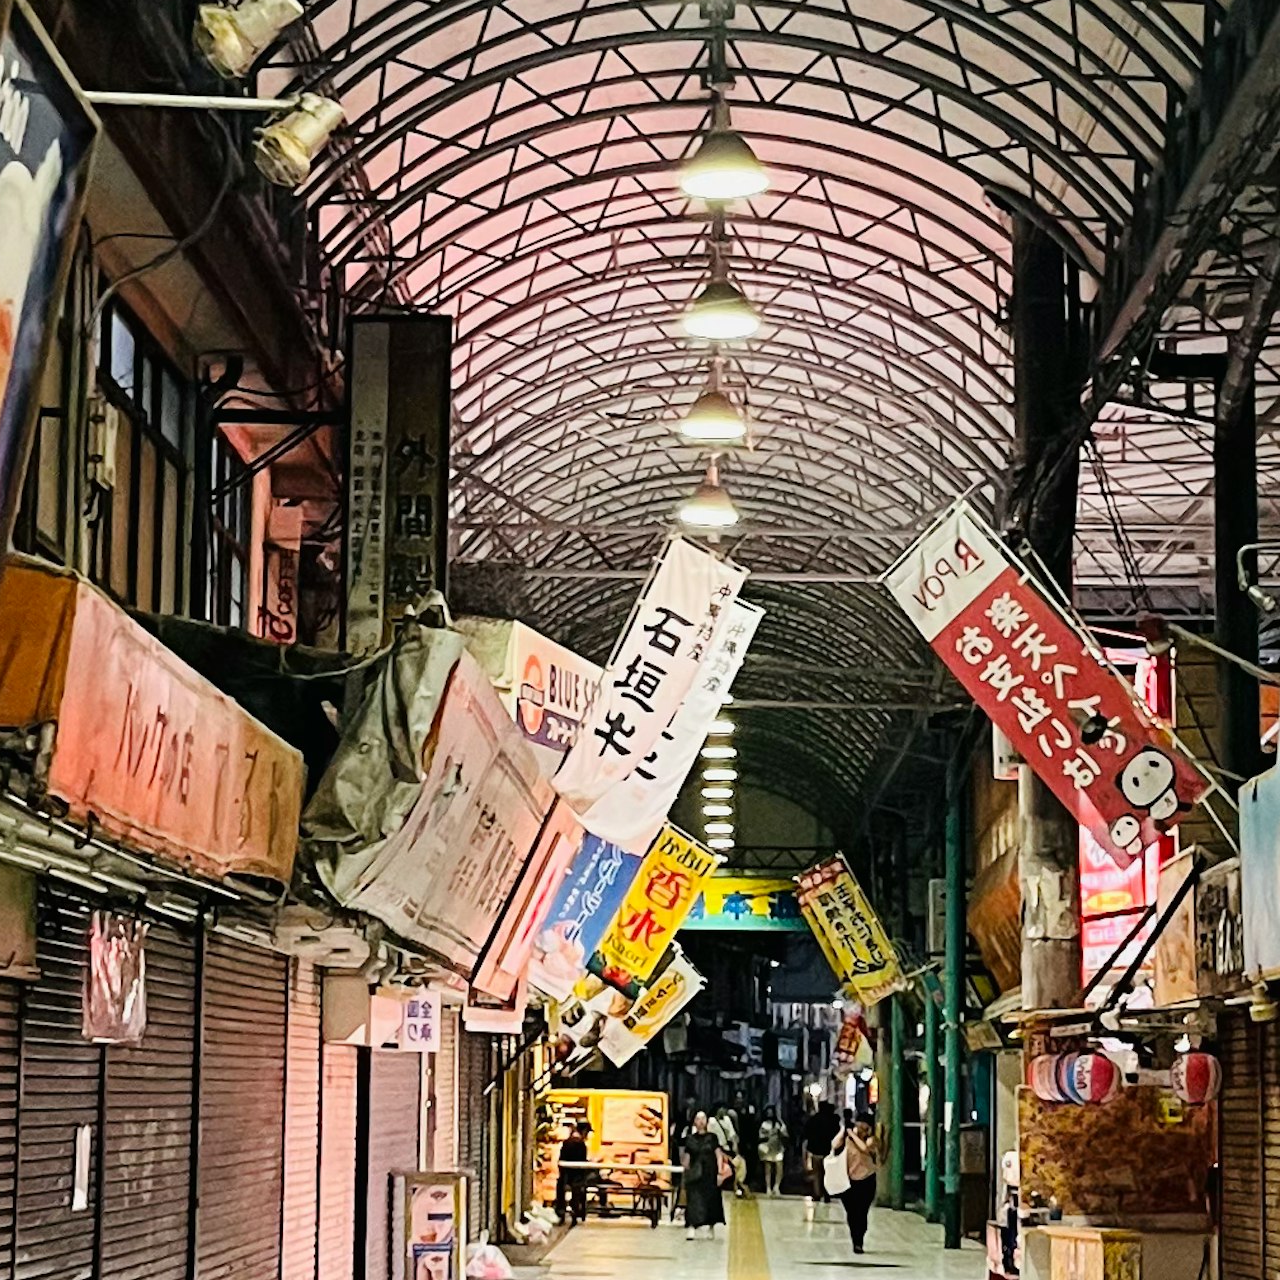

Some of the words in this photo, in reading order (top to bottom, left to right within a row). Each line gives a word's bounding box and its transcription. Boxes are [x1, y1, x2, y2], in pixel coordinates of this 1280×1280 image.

[549, 664, 580, 713] BLUE
[594, 606, 695, 757] 石垣牛
[617, 863, 692, 952] 香水
